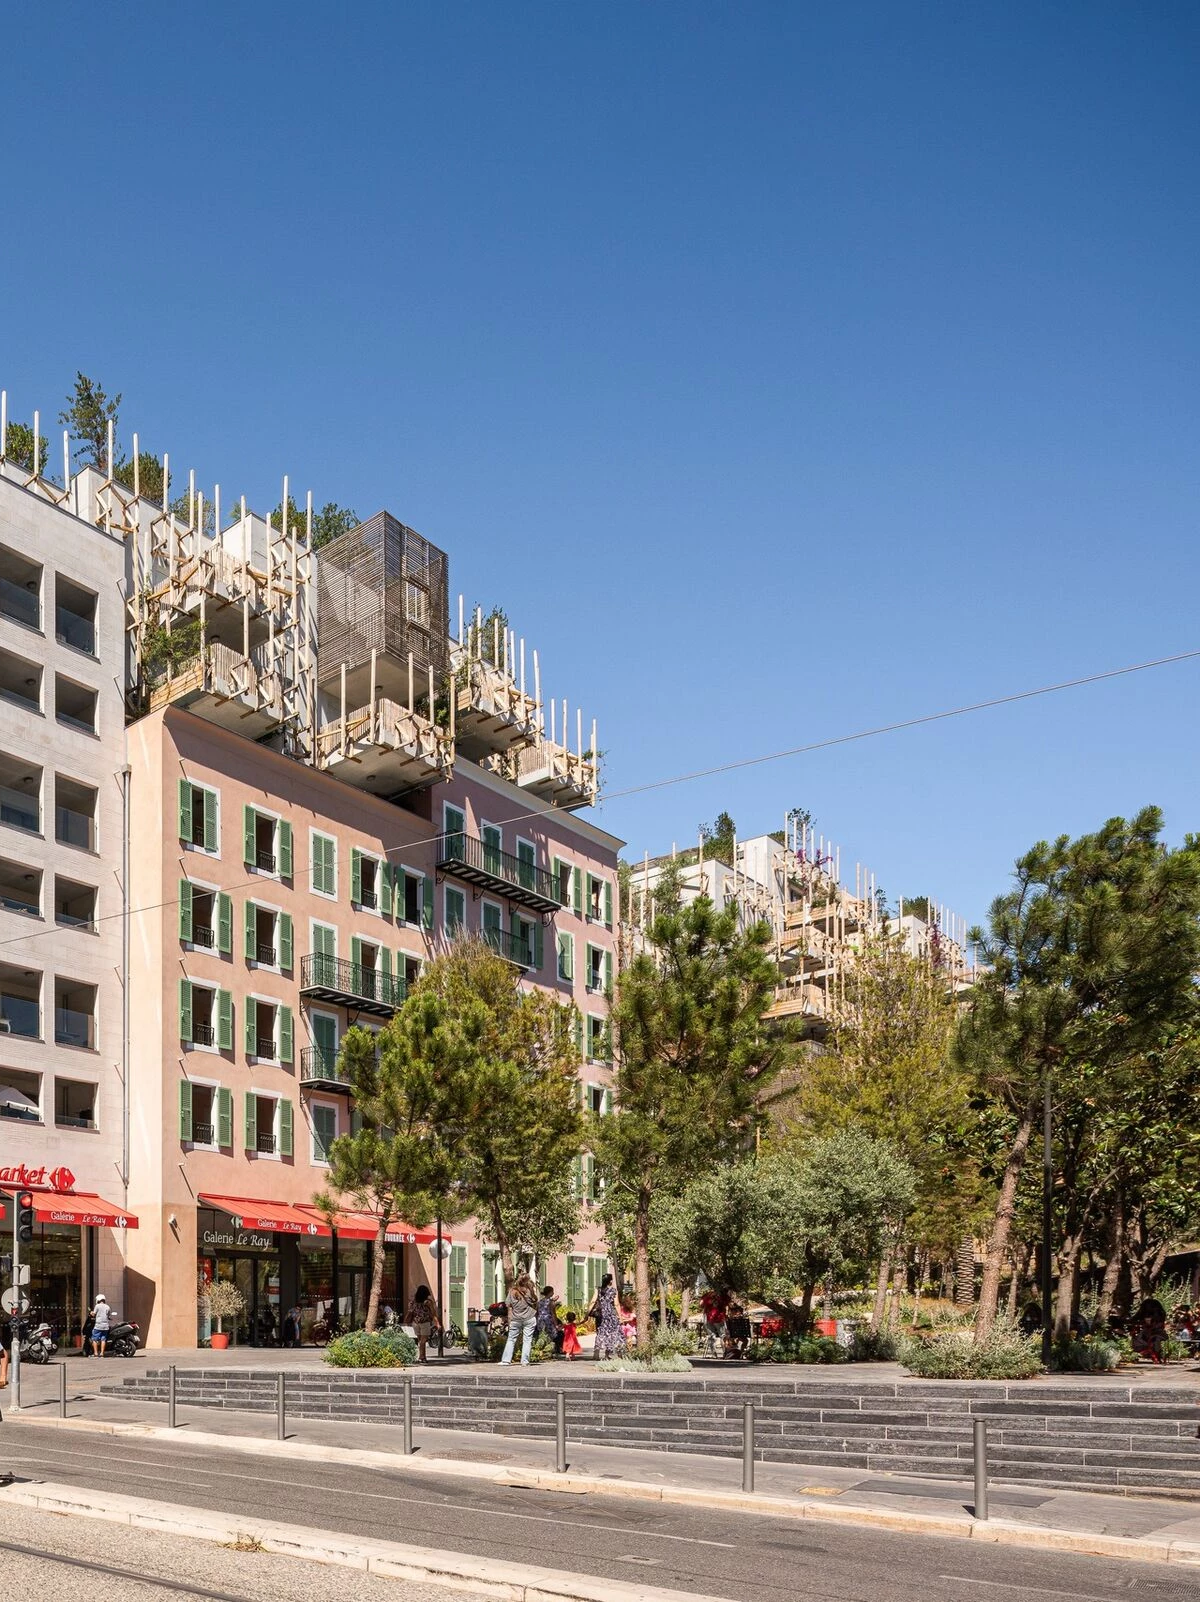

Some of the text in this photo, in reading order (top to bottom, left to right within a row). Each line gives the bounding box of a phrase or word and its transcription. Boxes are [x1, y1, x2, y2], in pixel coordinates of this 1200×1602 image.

[50, 1211, 106, 1226] Galerie Le Ray
[257, 1219, 302, 1233] Galerie Le Ray
[203, 1230, 272, 1251] Galerie Le Ray
